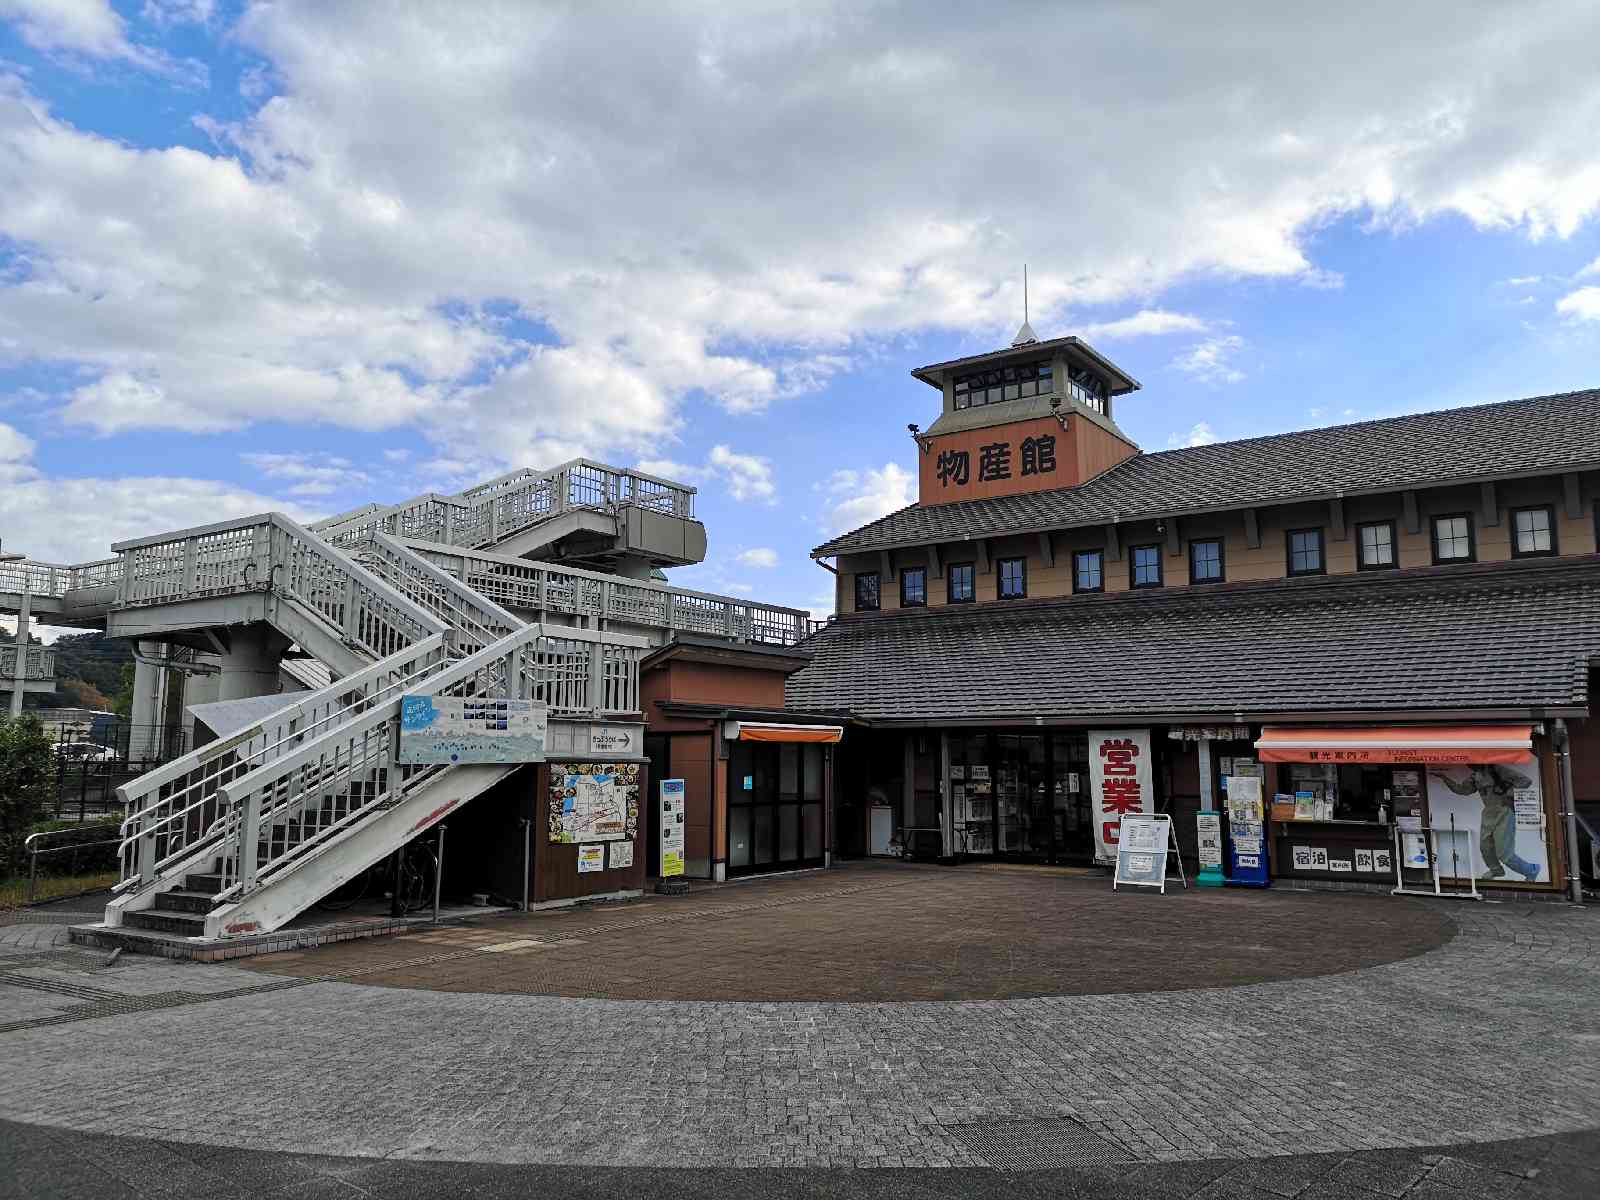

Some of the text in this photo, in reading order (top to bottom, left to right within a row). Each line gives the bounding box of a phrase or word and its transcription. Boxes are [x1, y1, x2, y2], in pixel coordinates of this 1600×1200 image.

[936, 434, 1057, 487] 物産館
[1296, 851, 1326, 864] 宿泊
[1358, 853, 1391, 867] 飲食
